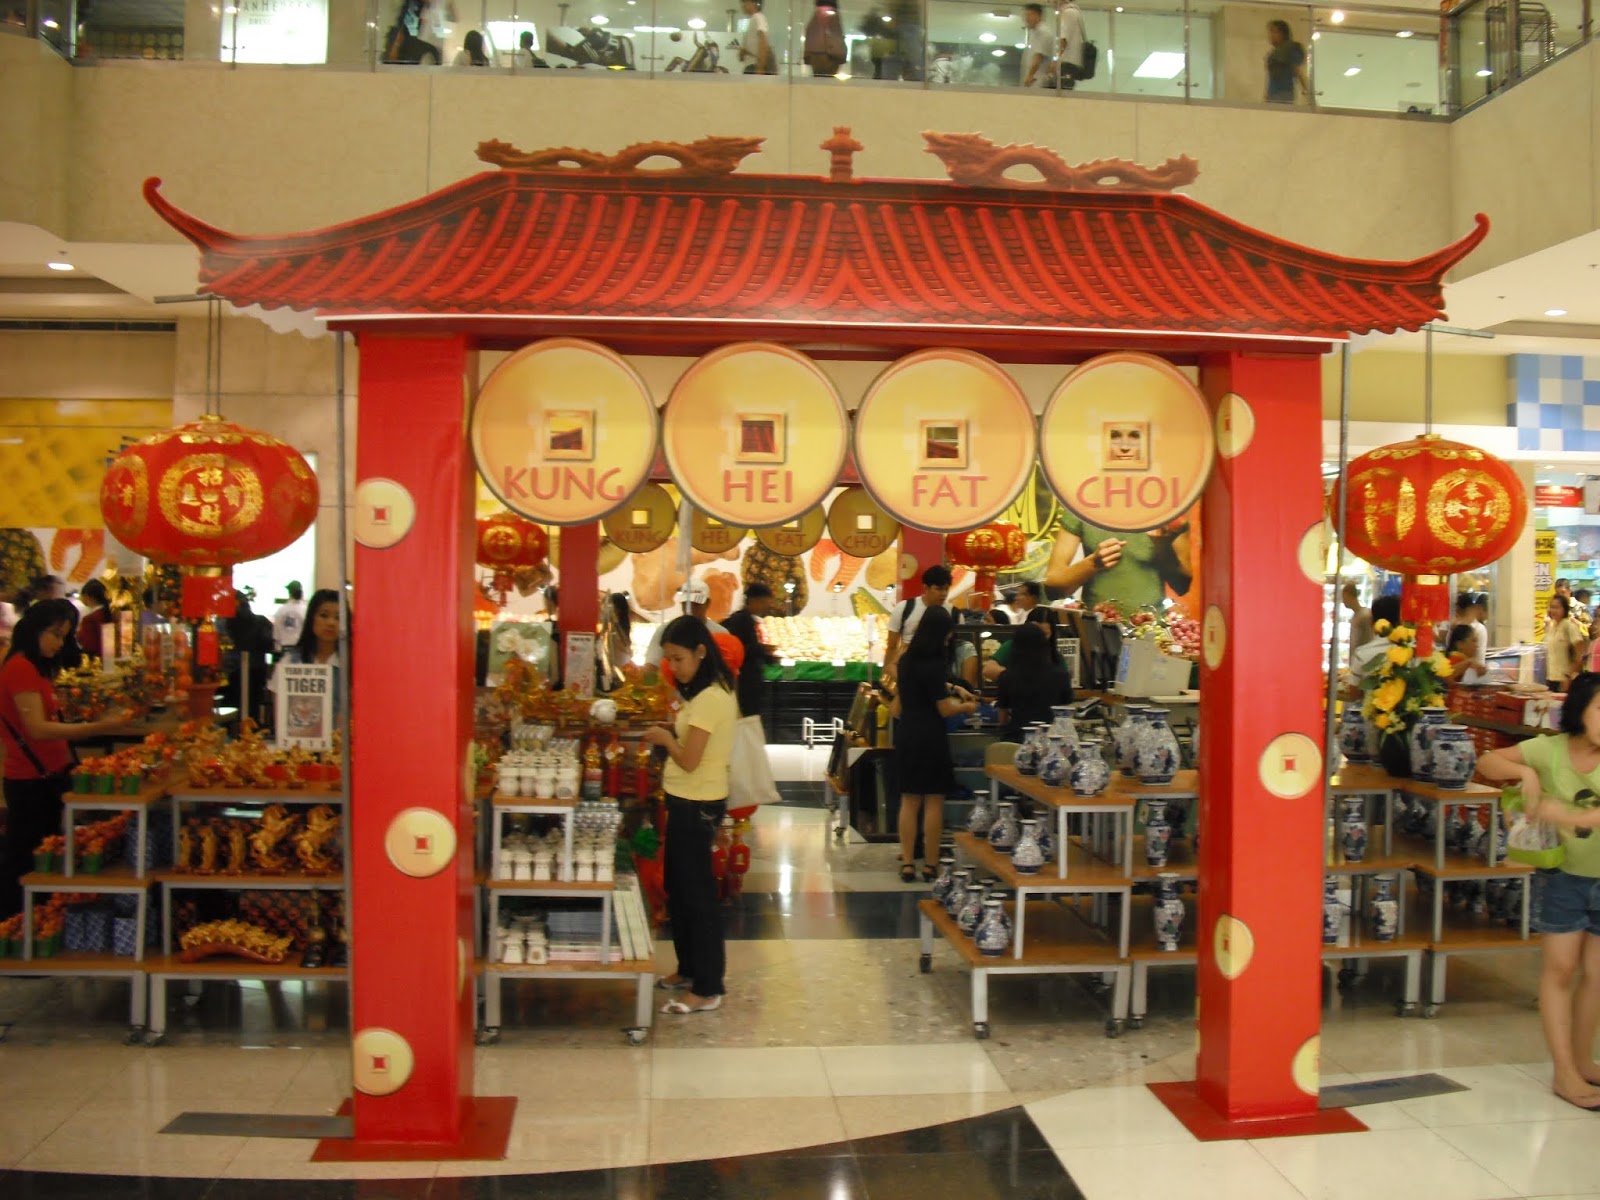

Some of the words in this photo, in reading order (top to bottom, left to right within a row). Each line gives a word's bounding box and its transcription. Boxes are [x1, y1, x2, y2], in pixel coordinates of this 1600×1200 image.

[504, 466, 625, 500] KUNG
[723, 469, 793, 503] HEI
[911, 474, 989, 507] FAT
[1076, 475, 1181, 508] CHOI
[616, 530, 662, 543] KUNG
[701, 530, 731, 543] HEI
[775, 533, 804, 548] FAT
[843, 535, 887, 550] CHOI
[286, 678, 326, 693] TIGER
